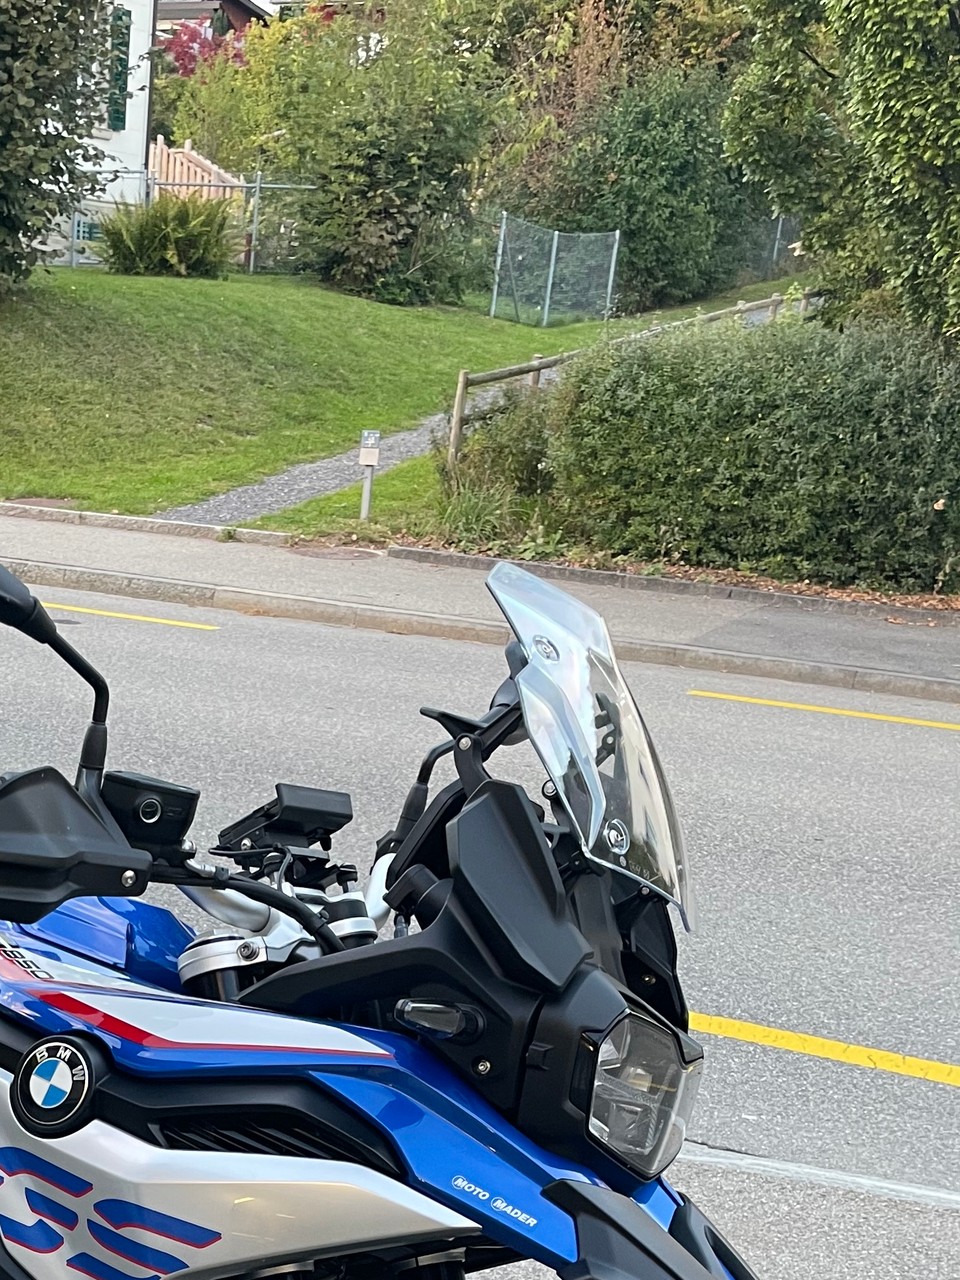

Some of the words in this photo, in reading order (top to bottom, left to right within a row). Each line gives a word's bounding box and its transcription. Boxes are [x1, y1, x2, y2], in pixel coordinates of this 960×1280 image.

[34, 1046, 86, 1082] BMW
[451, 1175, 490, 1201] MOTO
[490, 1197, 538, 1228] MADER
